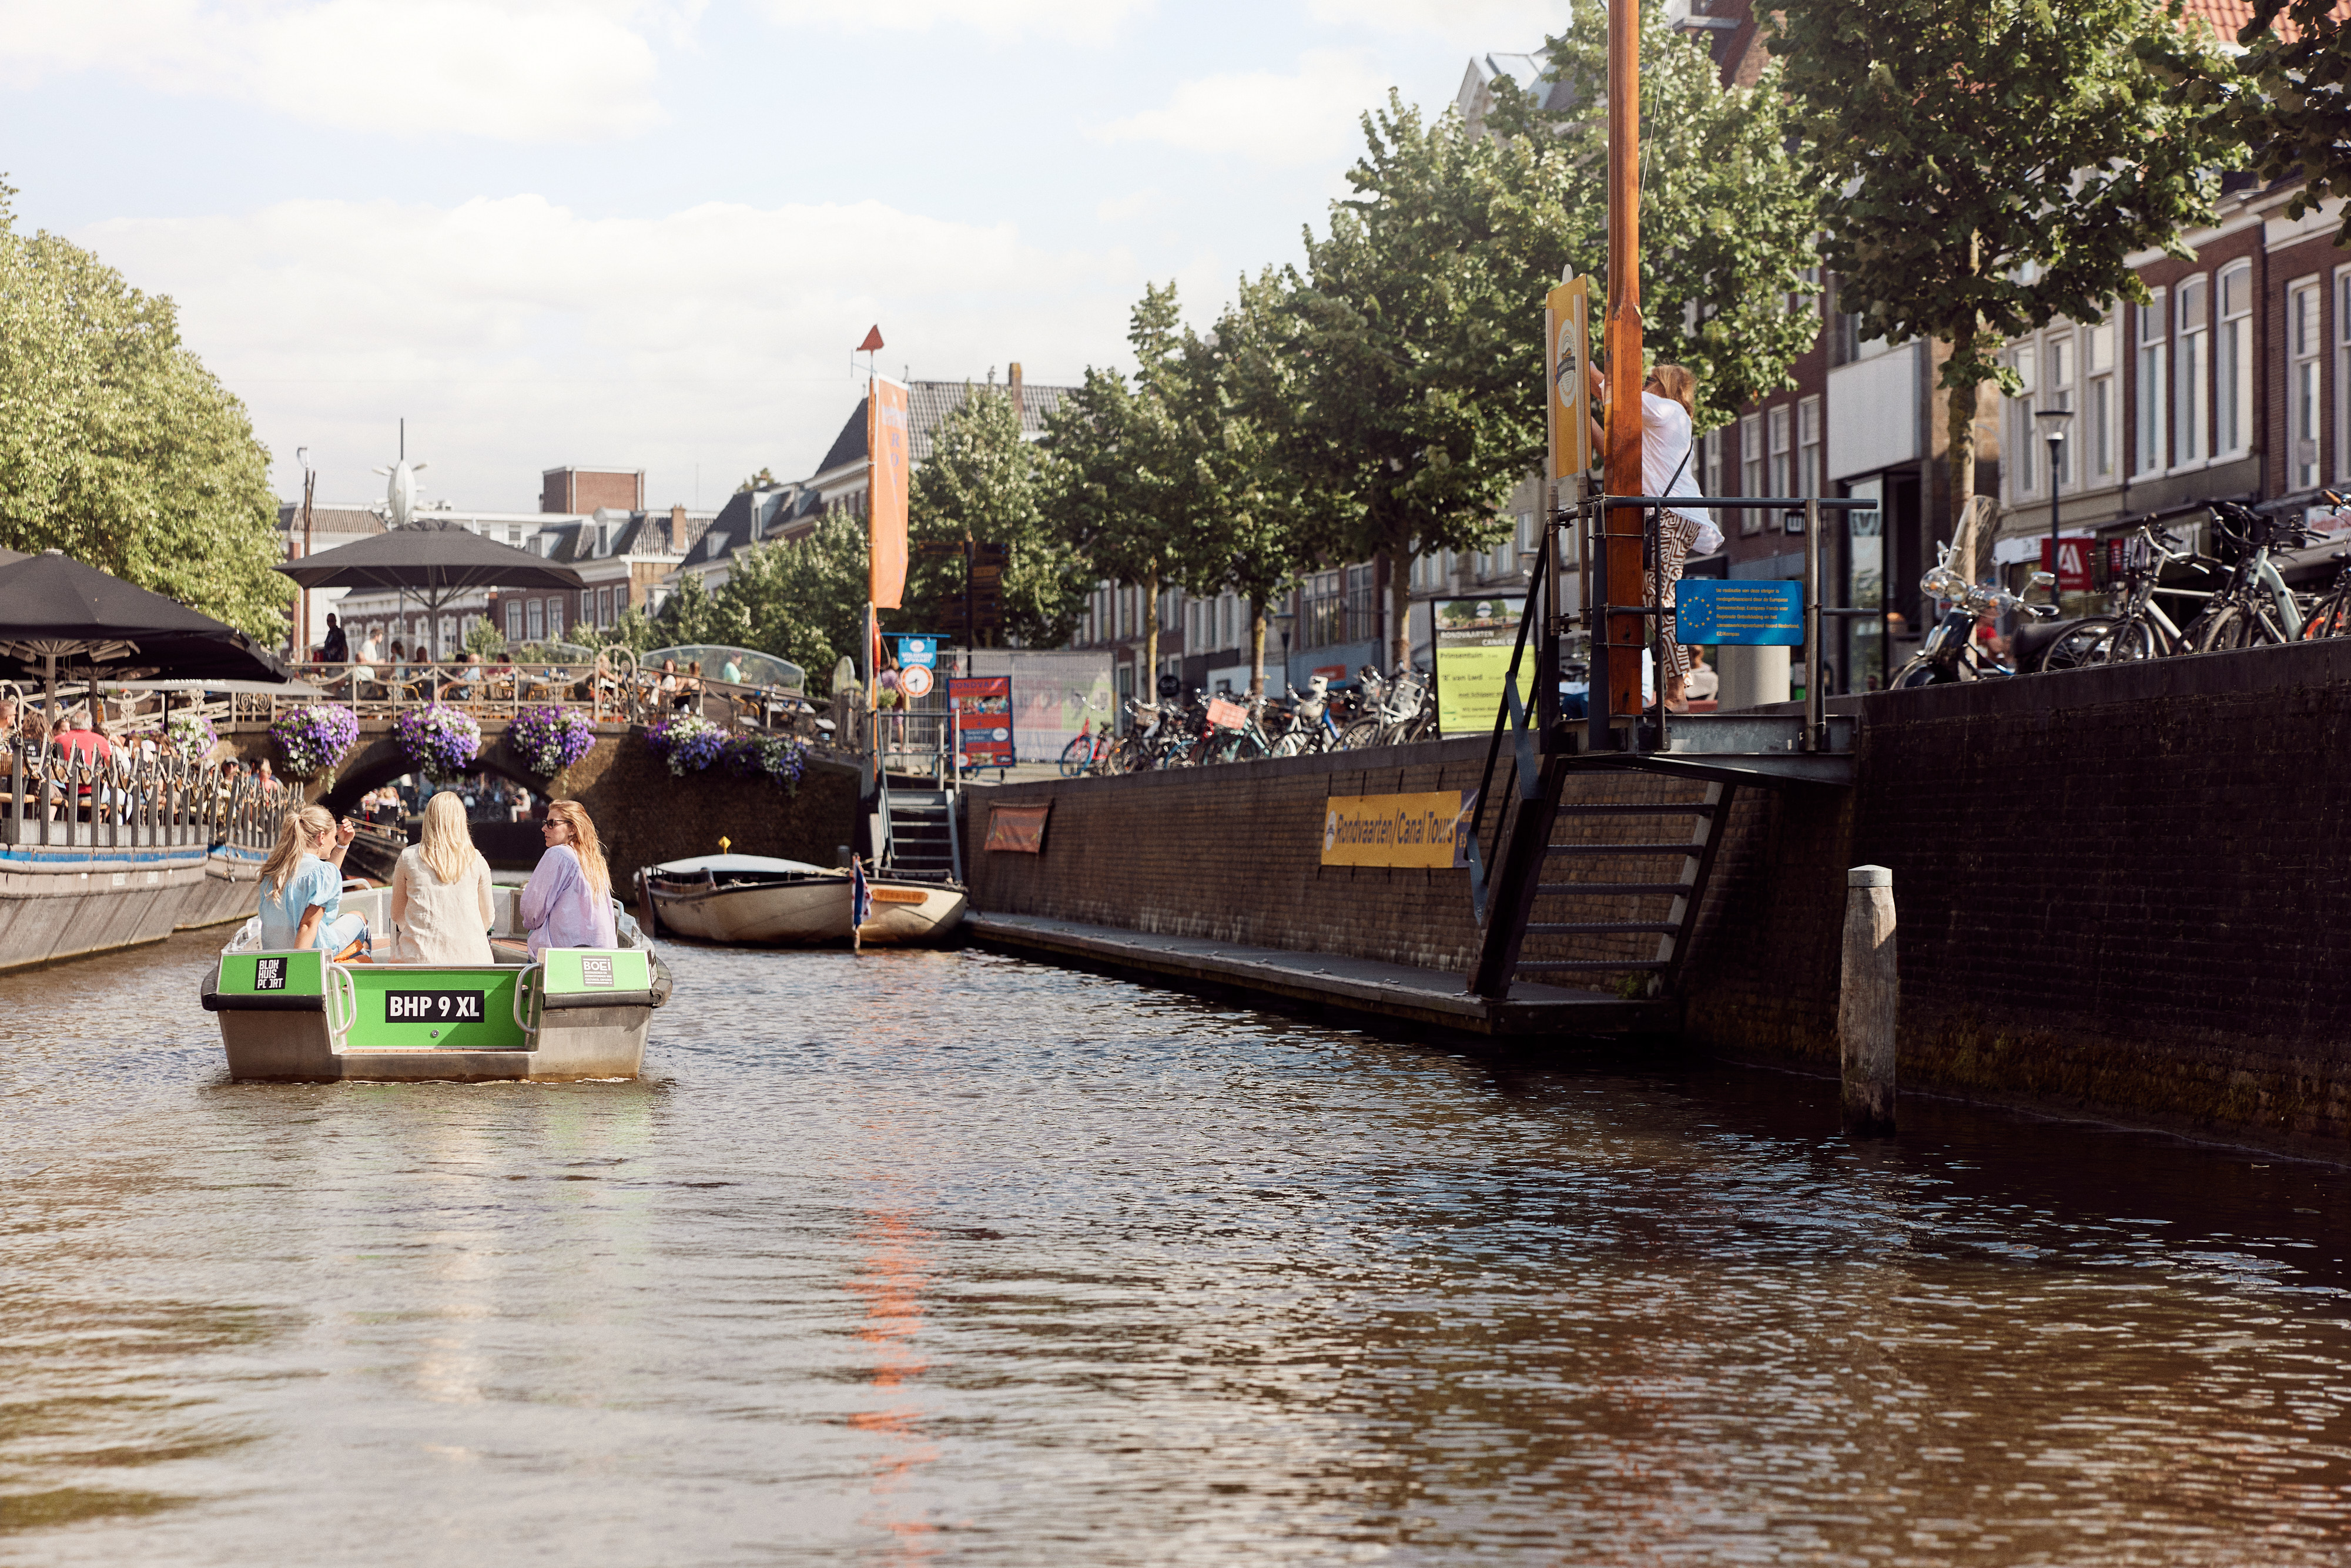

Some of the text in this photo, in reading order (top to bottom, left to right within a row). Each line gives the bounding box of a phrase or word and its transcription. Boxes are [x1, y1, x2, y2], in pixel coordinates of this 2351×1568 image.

[1335, 808, 1427, 849] Rondvaarten/Canal
[1427, 811, 1454, 844] Tours
[259, 959, 279, 970] BLOK
[258, 969, 277, 979] HUIS
[390, 996, 480, 1017] BHP 9 XL
